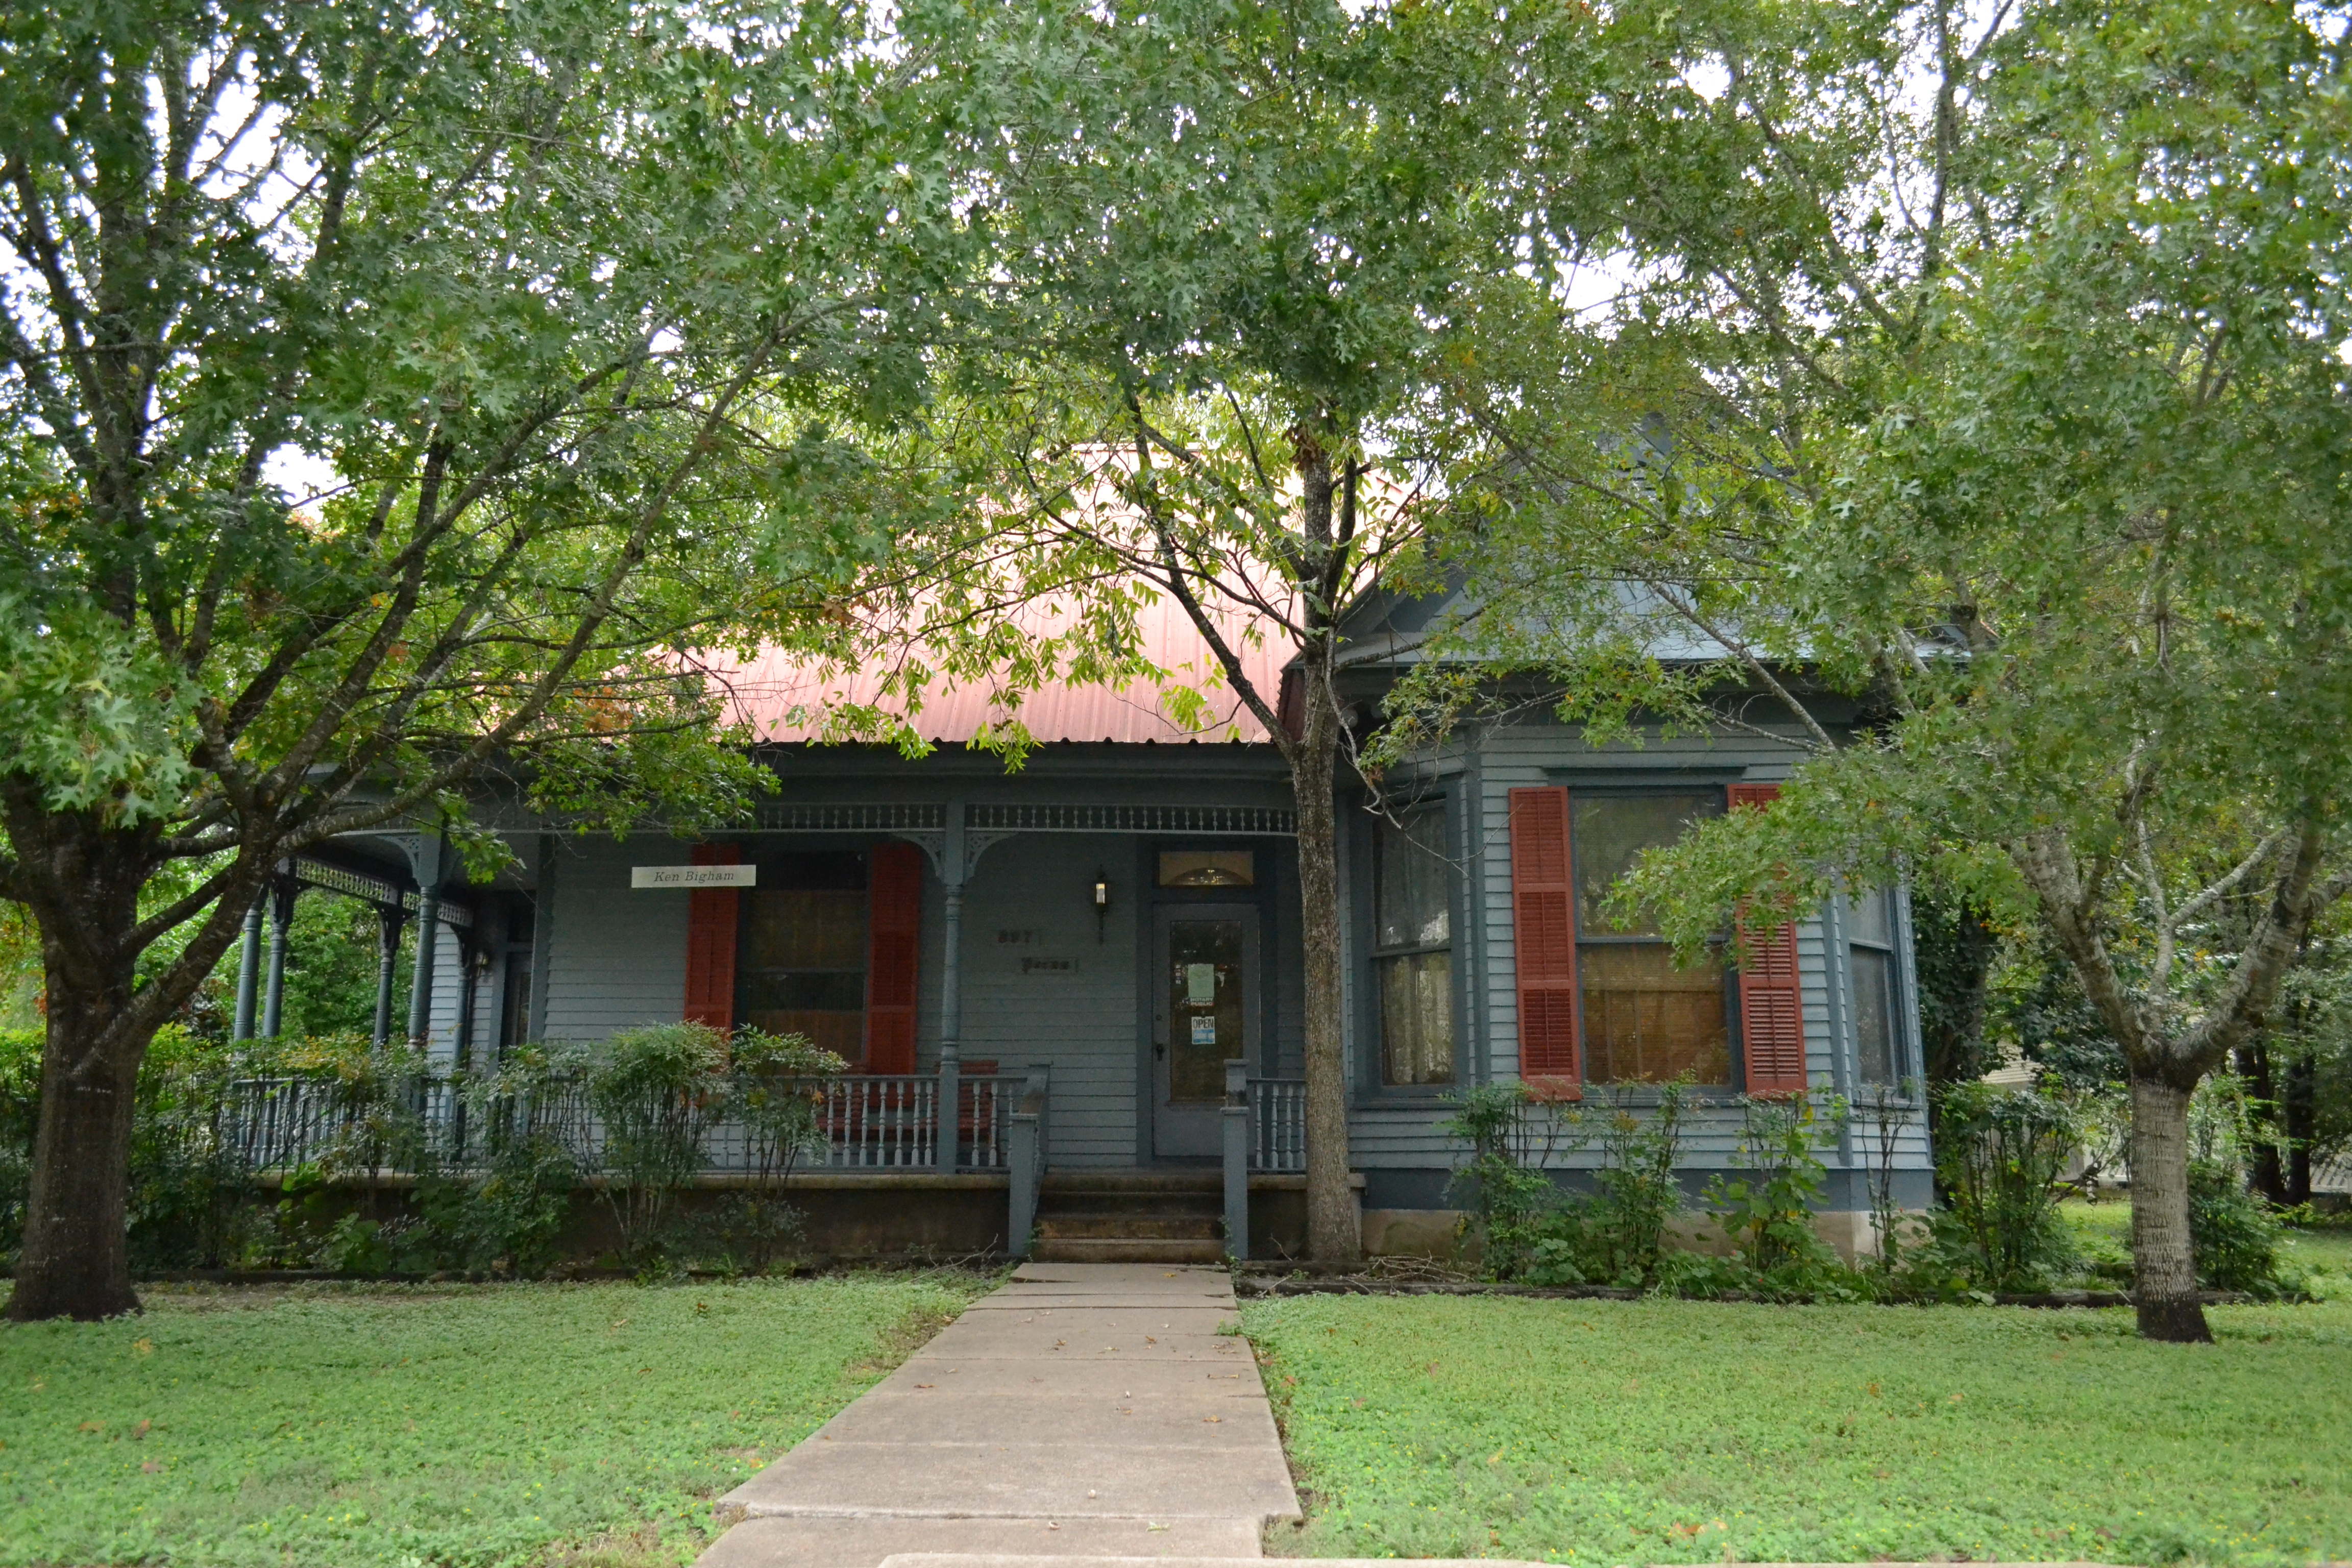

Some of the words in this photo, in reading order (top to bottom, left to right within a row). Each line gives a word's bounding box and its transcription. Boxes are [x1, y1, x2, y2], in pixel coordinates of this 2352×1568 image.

[654, 872, 679, 882] Ken
[685, 871, 734, 884] Bigham
[1193, 1018, 1214, 1029] OPEN
